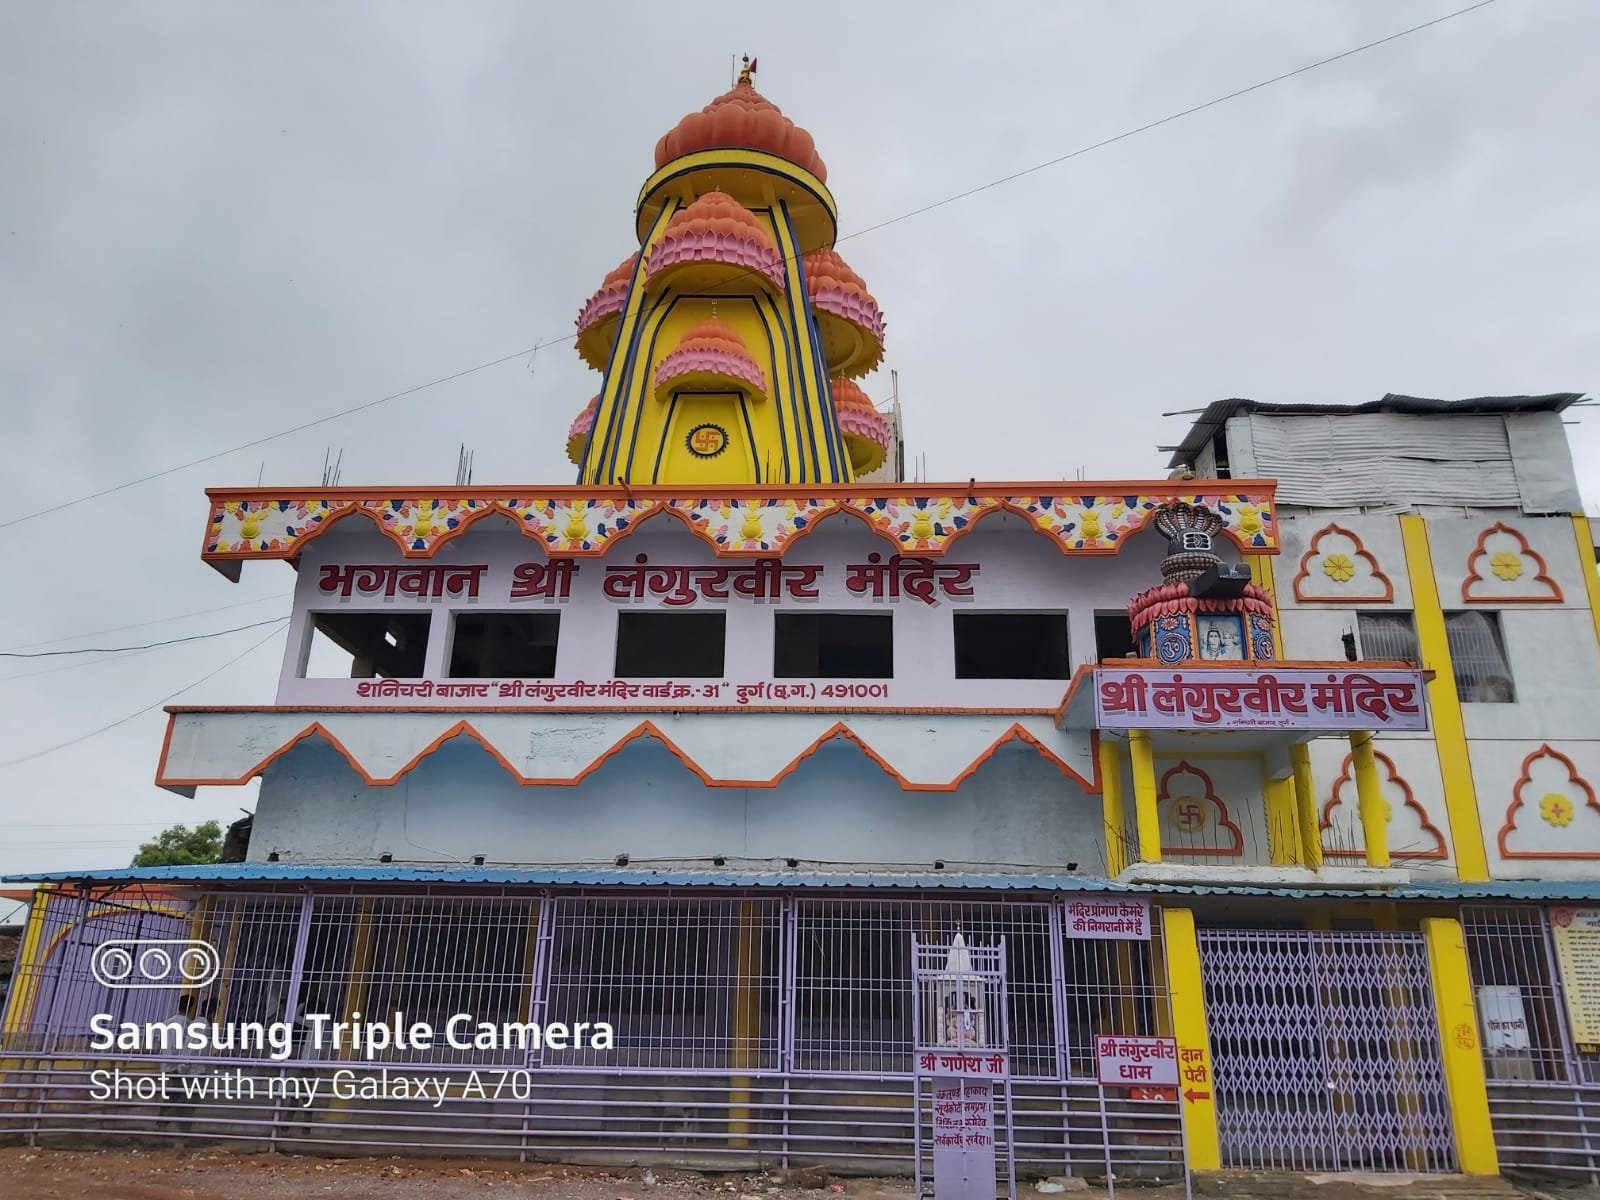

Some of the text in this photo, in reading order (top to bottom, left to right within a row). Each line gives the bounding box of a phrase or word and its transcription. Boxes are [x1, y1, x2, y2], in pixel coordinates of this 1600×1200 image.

[319, 553, 980, 606] भगवान श्री लंगुरवीर मंदिर
[357, 680, 434, 698] शनिचरी
[436, 683, 490, 698] बाजार
[526, 680, 598, 702] लंगुरवीर
[598, 679, 641, 700] मंदिर
[642, 681, 673, 698] वार्ड
[736, 681, 765, 704] दुर्ग
[820, 683, 889, 698] 491001
[1100, 674, 1419, 723] श्री लंगुरवीर मंदिर
[1068, 901, 1144, 918] मंदिर प्रांगण कैमरे
[1073, 917, 1143, 936] की निगरानी में है
[1100, 1038, 1175, 1063] श्री लंगुरवीर
[1181, 1049, 1204, 1063] दान
[920, 1052, 1004, 1074] श्री गणेश जी
[1119, 1065, 1153, 1080] धाम
[1183, 1064, 1207, 1083] पेटी
